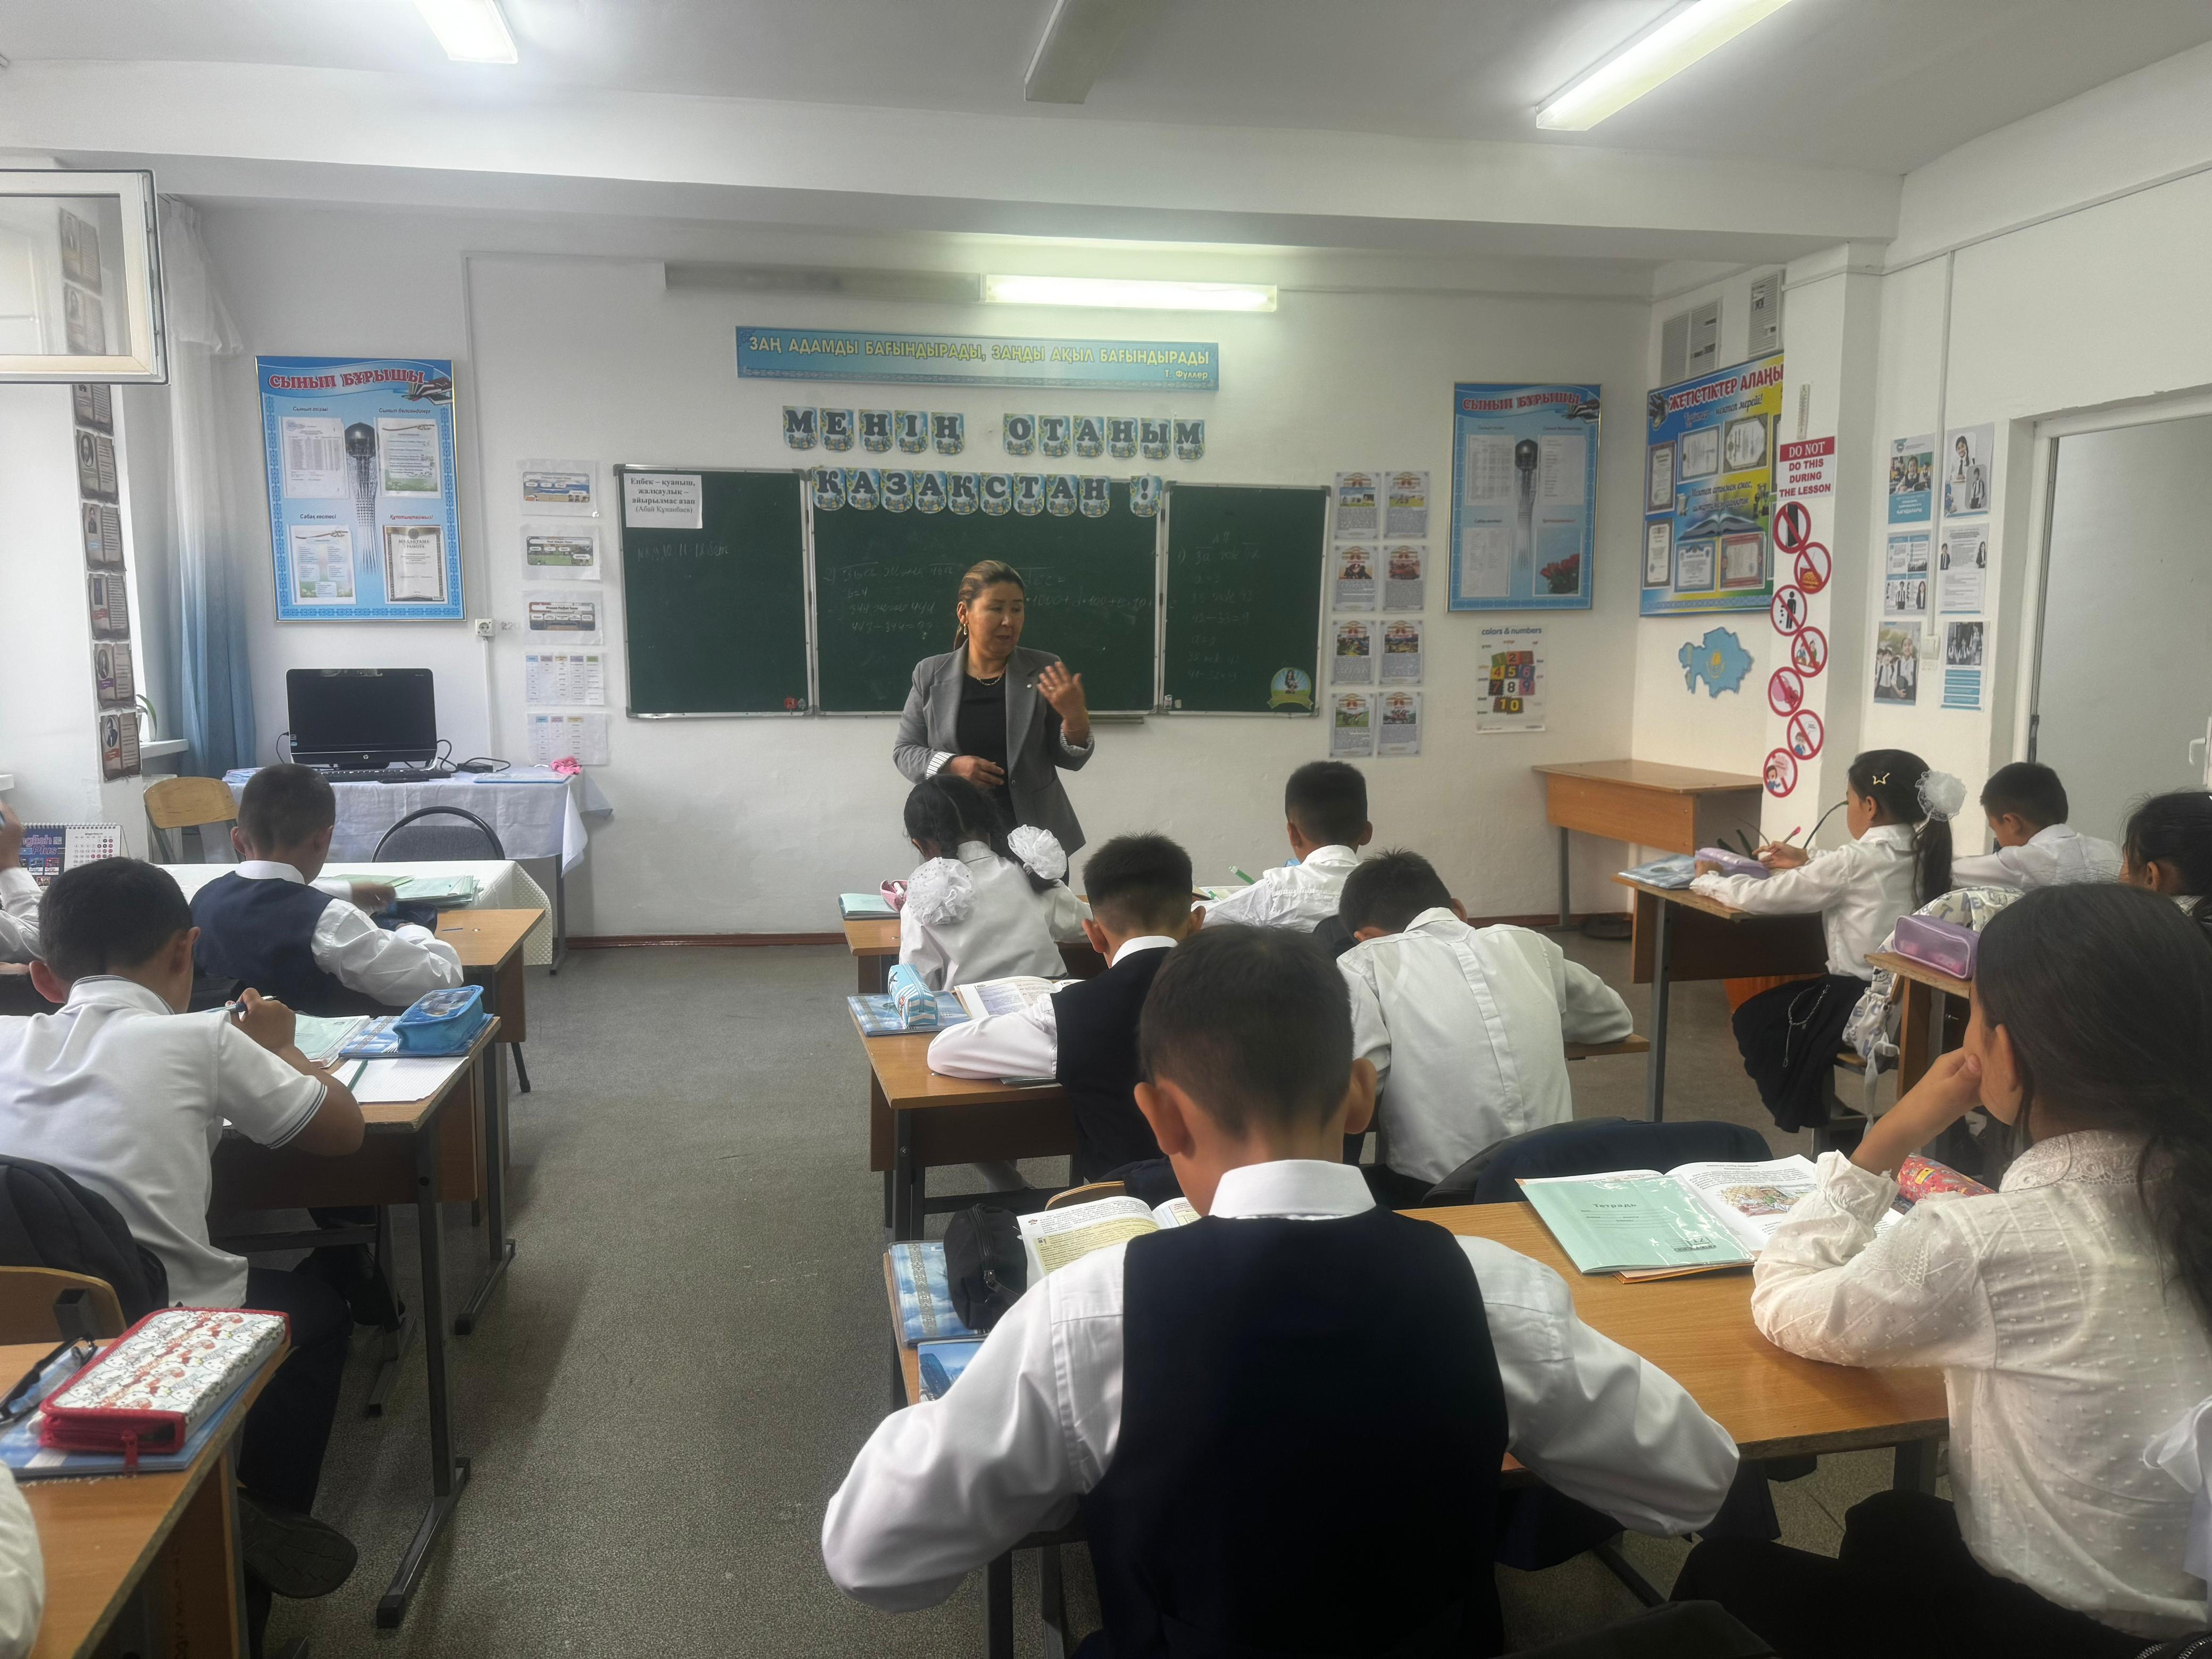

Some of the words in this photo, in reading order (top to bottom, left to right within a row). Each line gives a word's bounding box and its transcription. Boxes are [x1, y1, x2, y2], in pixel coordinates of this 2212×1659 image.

[749, 336, 782, 354] ЗАҢ
[788, 338, 859, 356] АДАМДЫ
[865, 340, 986, 362] БАҒЫНДЫРАДЫ,
[991, 345, 1045, 363] ЗАҢДЫ
[1051, 347, 1094, 364] АҚЫЛ
[1100, 348, 1209, 366] БАҒЫНДЫРАДЫ
[269, 374, 337, 389] СЫНЫП
[342, 368, 425, 387] БҰРЫШЫ
[1164, 370, 1172, 378] Т.
[1175, 370, 1208, 381] Фуллер
[1463, 398, 1513, 411] СЫНЫП
[1517, 392, 1581, 409] БҰРЫШЫ
[1669, 378, 1738, 411] ЖЕТІСТІКТЕР
[785, 409, 960, 441] МЕНІҢ
[1009, 417, 1202, 445] ОТАНЫМ
[1789, 446, 1802, 458] DO
[1805, 441, 1825, 456] NOT
[1789, 462, 1801, 472] DO
[1803, 458, 1824, 470] THIS
[1789, 472, 1822, 483] DURING
[817, 470, 1106, 501] ҚАЗАҚСТАН
[1779, 488, 1796, 498] THE
[1798, 483, 1831, 496] LESSON
[1509, 652, 1516, 663] 2
[1494, 666, 1501, 677] 4
[1508, 666, 1516, 676] 5
[1522, 667, 1531, 677] 6
[1493, 682, 1501, 693] 7
[1507, 681, 1515, 693] 8
[22, 834, 52, 847] nglish
[32, 845, 58, 856] Plus
